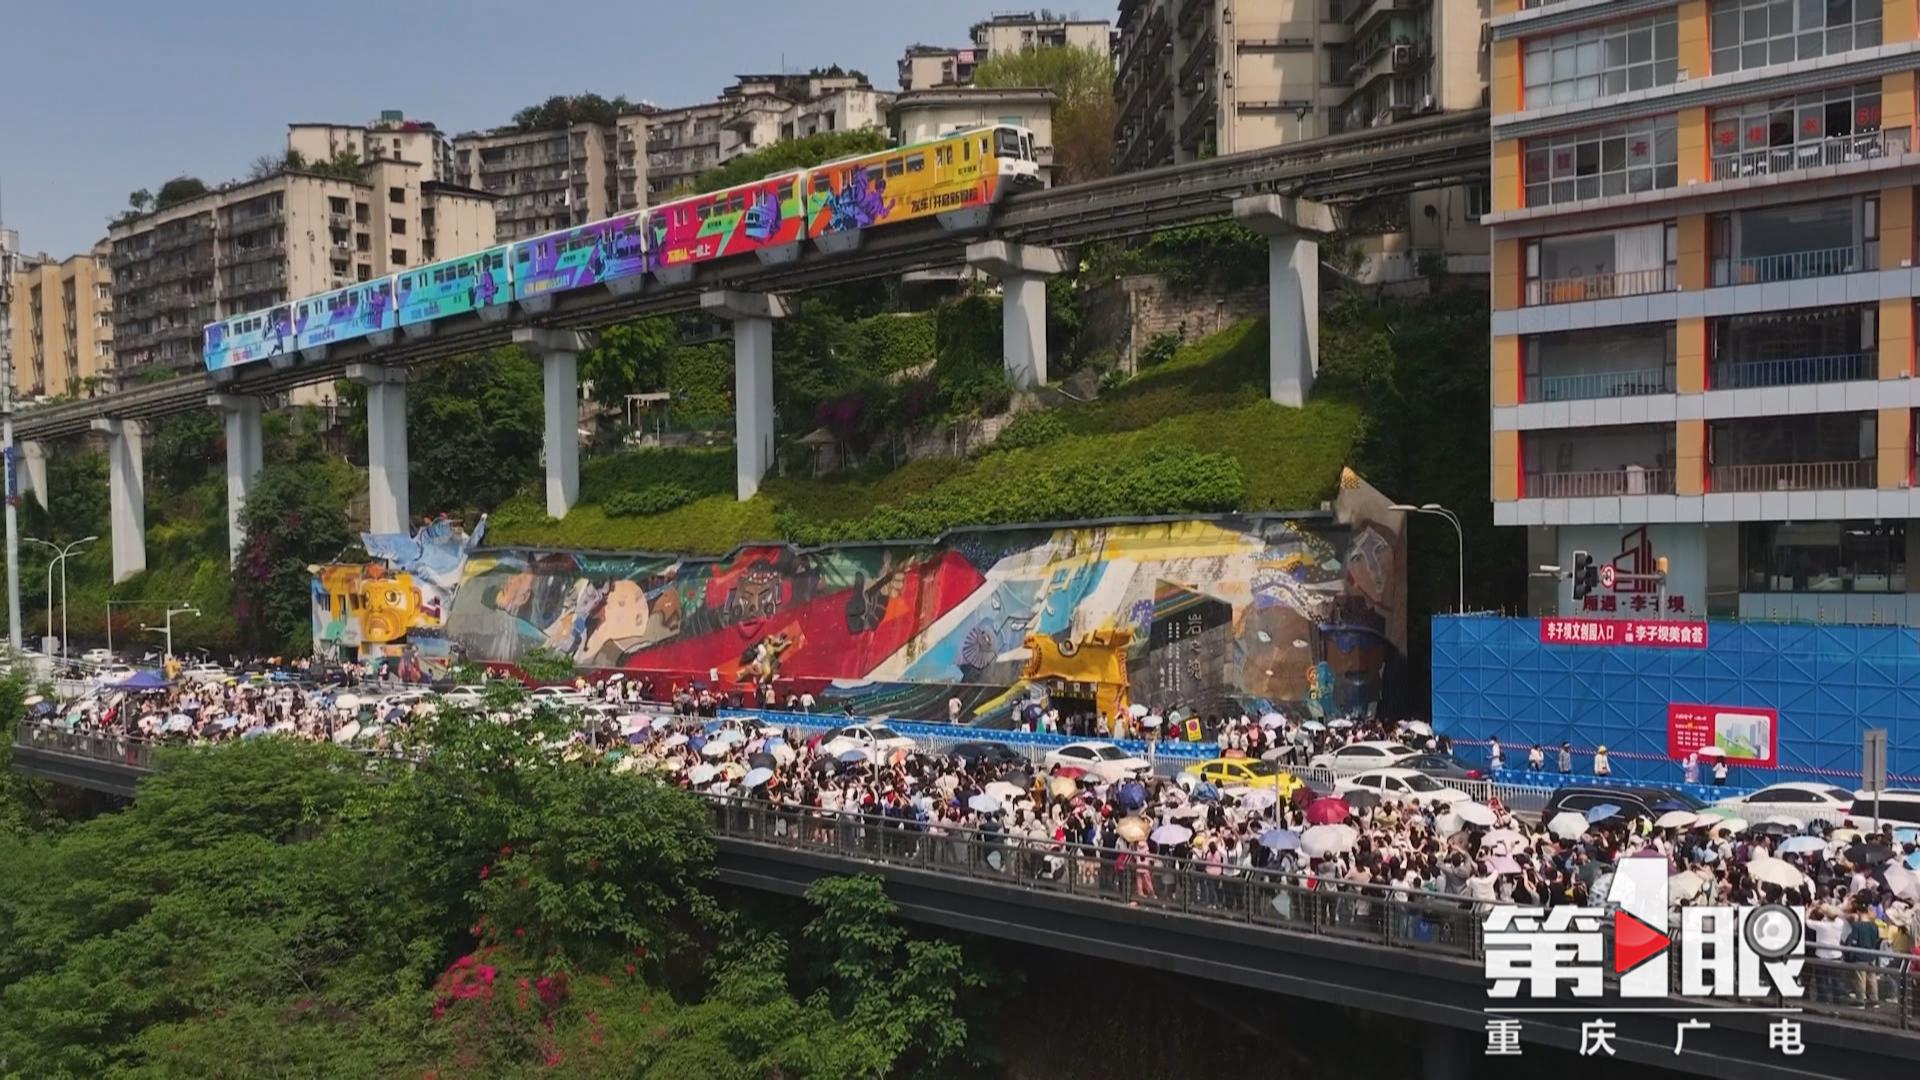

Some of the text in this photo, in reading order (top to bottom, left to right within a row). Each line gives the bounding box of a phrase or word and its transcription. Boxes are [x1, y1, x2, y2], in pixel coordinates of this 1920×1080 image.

[1548, 622, 1614, 641] 李子坝文创园入口
